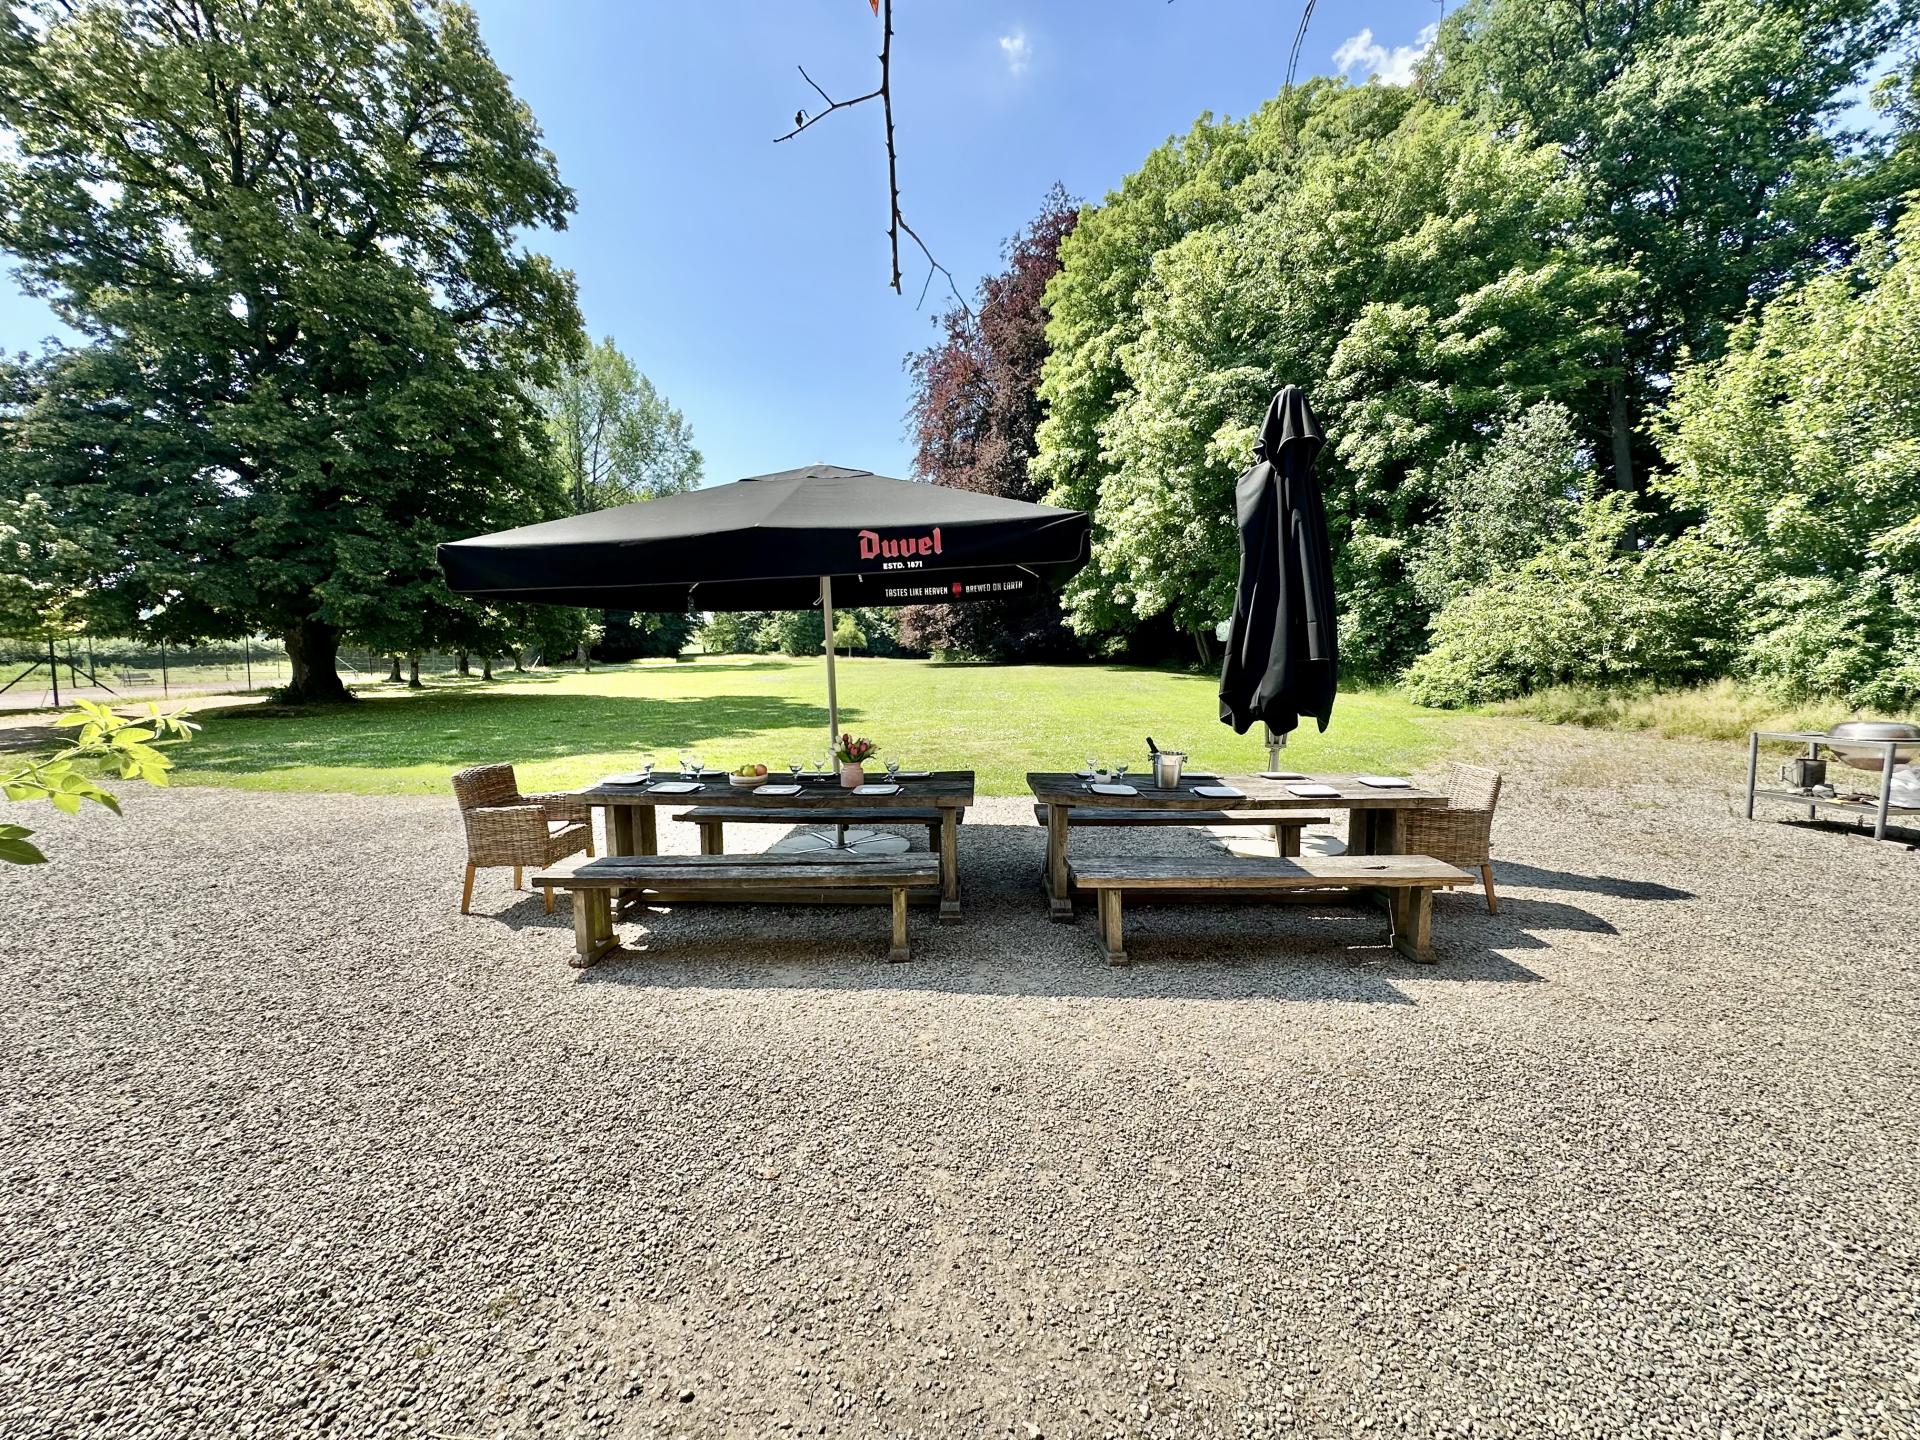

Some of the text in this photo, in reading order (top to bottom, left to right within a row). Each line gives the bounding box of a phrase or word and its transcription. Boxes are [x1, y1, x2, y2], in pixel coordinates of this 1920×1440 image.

[858, 527, 942, 559] Duvel
[883, 560, 923, 570] ESTD. 1871
[885, 580, 1023, 597] TASTES LIKE HEAVEN BREWED ON EARTH
